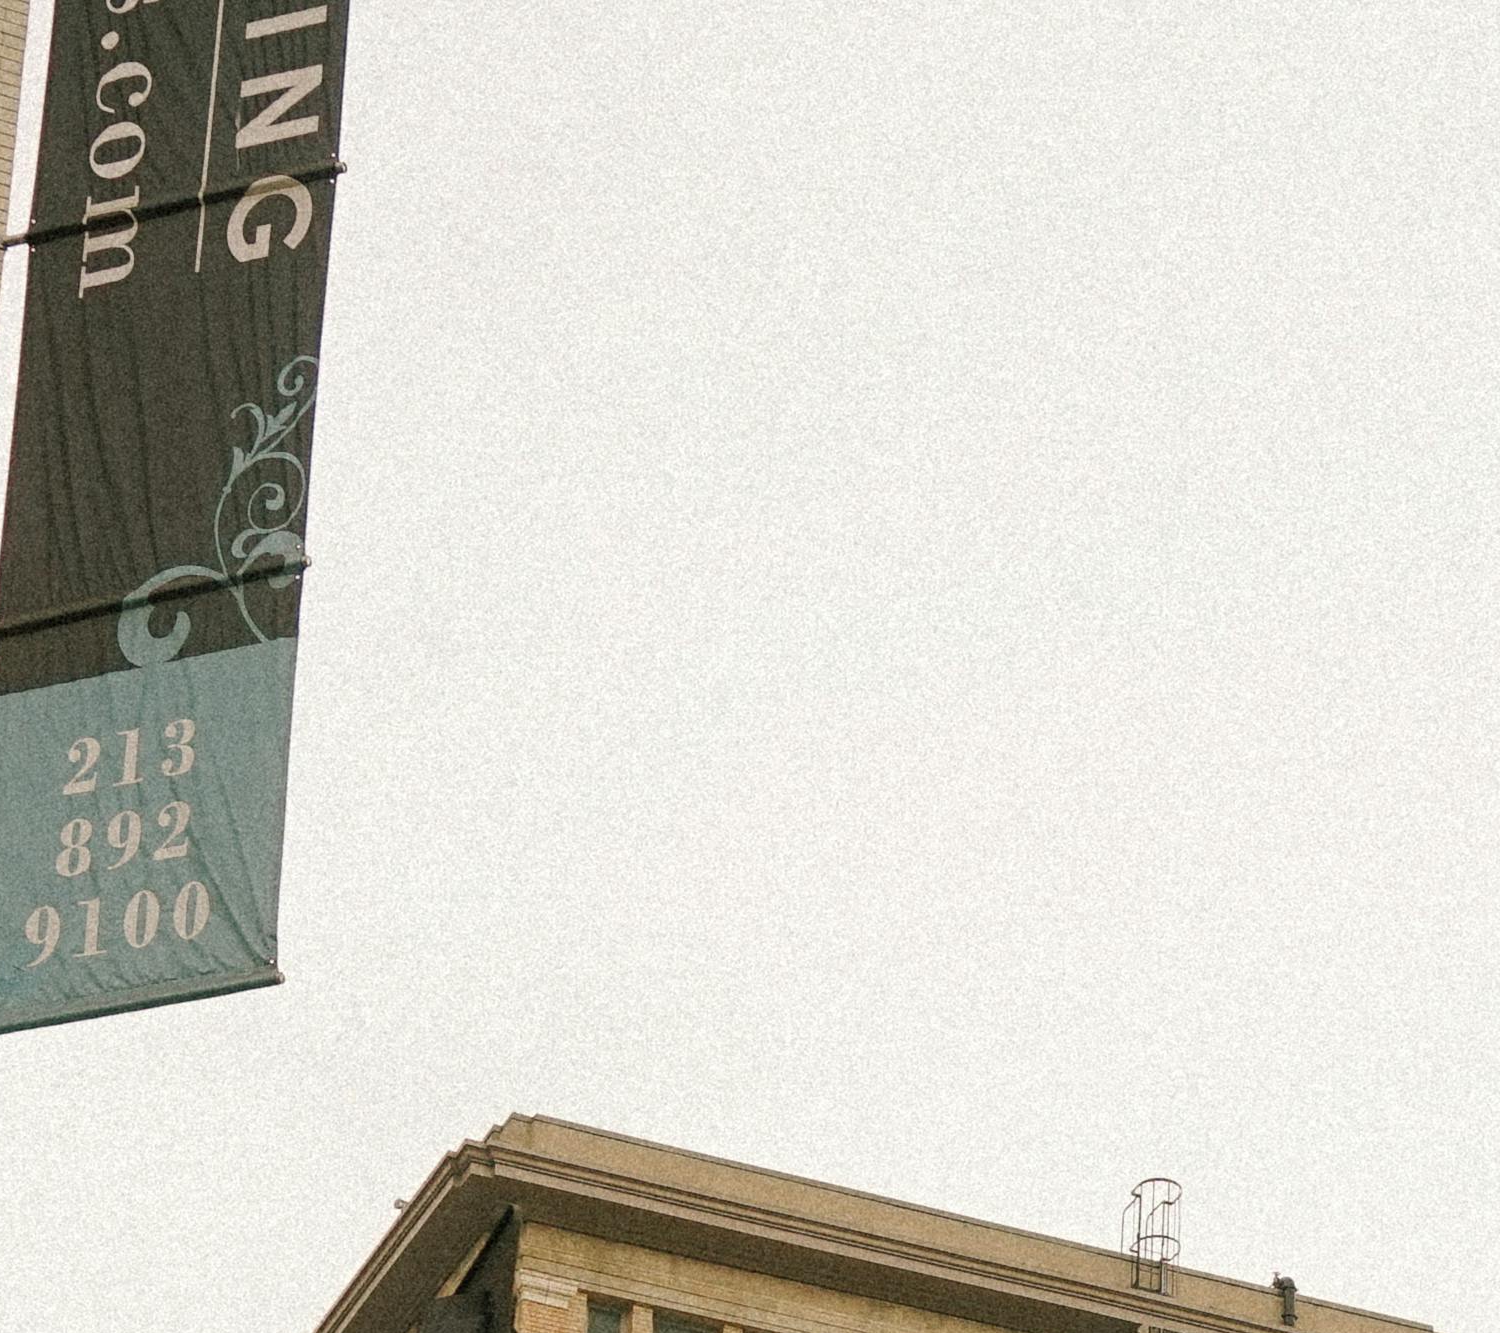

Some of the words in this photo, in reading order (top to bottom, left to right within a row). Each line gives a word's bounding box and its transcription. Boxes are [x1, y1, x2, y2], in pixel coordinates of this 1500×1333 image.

[77, 0, 153, 299] .com
[62, 718, 196, 796] 213
[55, 800, 192, 878] 892
[24, 880, 211, 969] 9100
